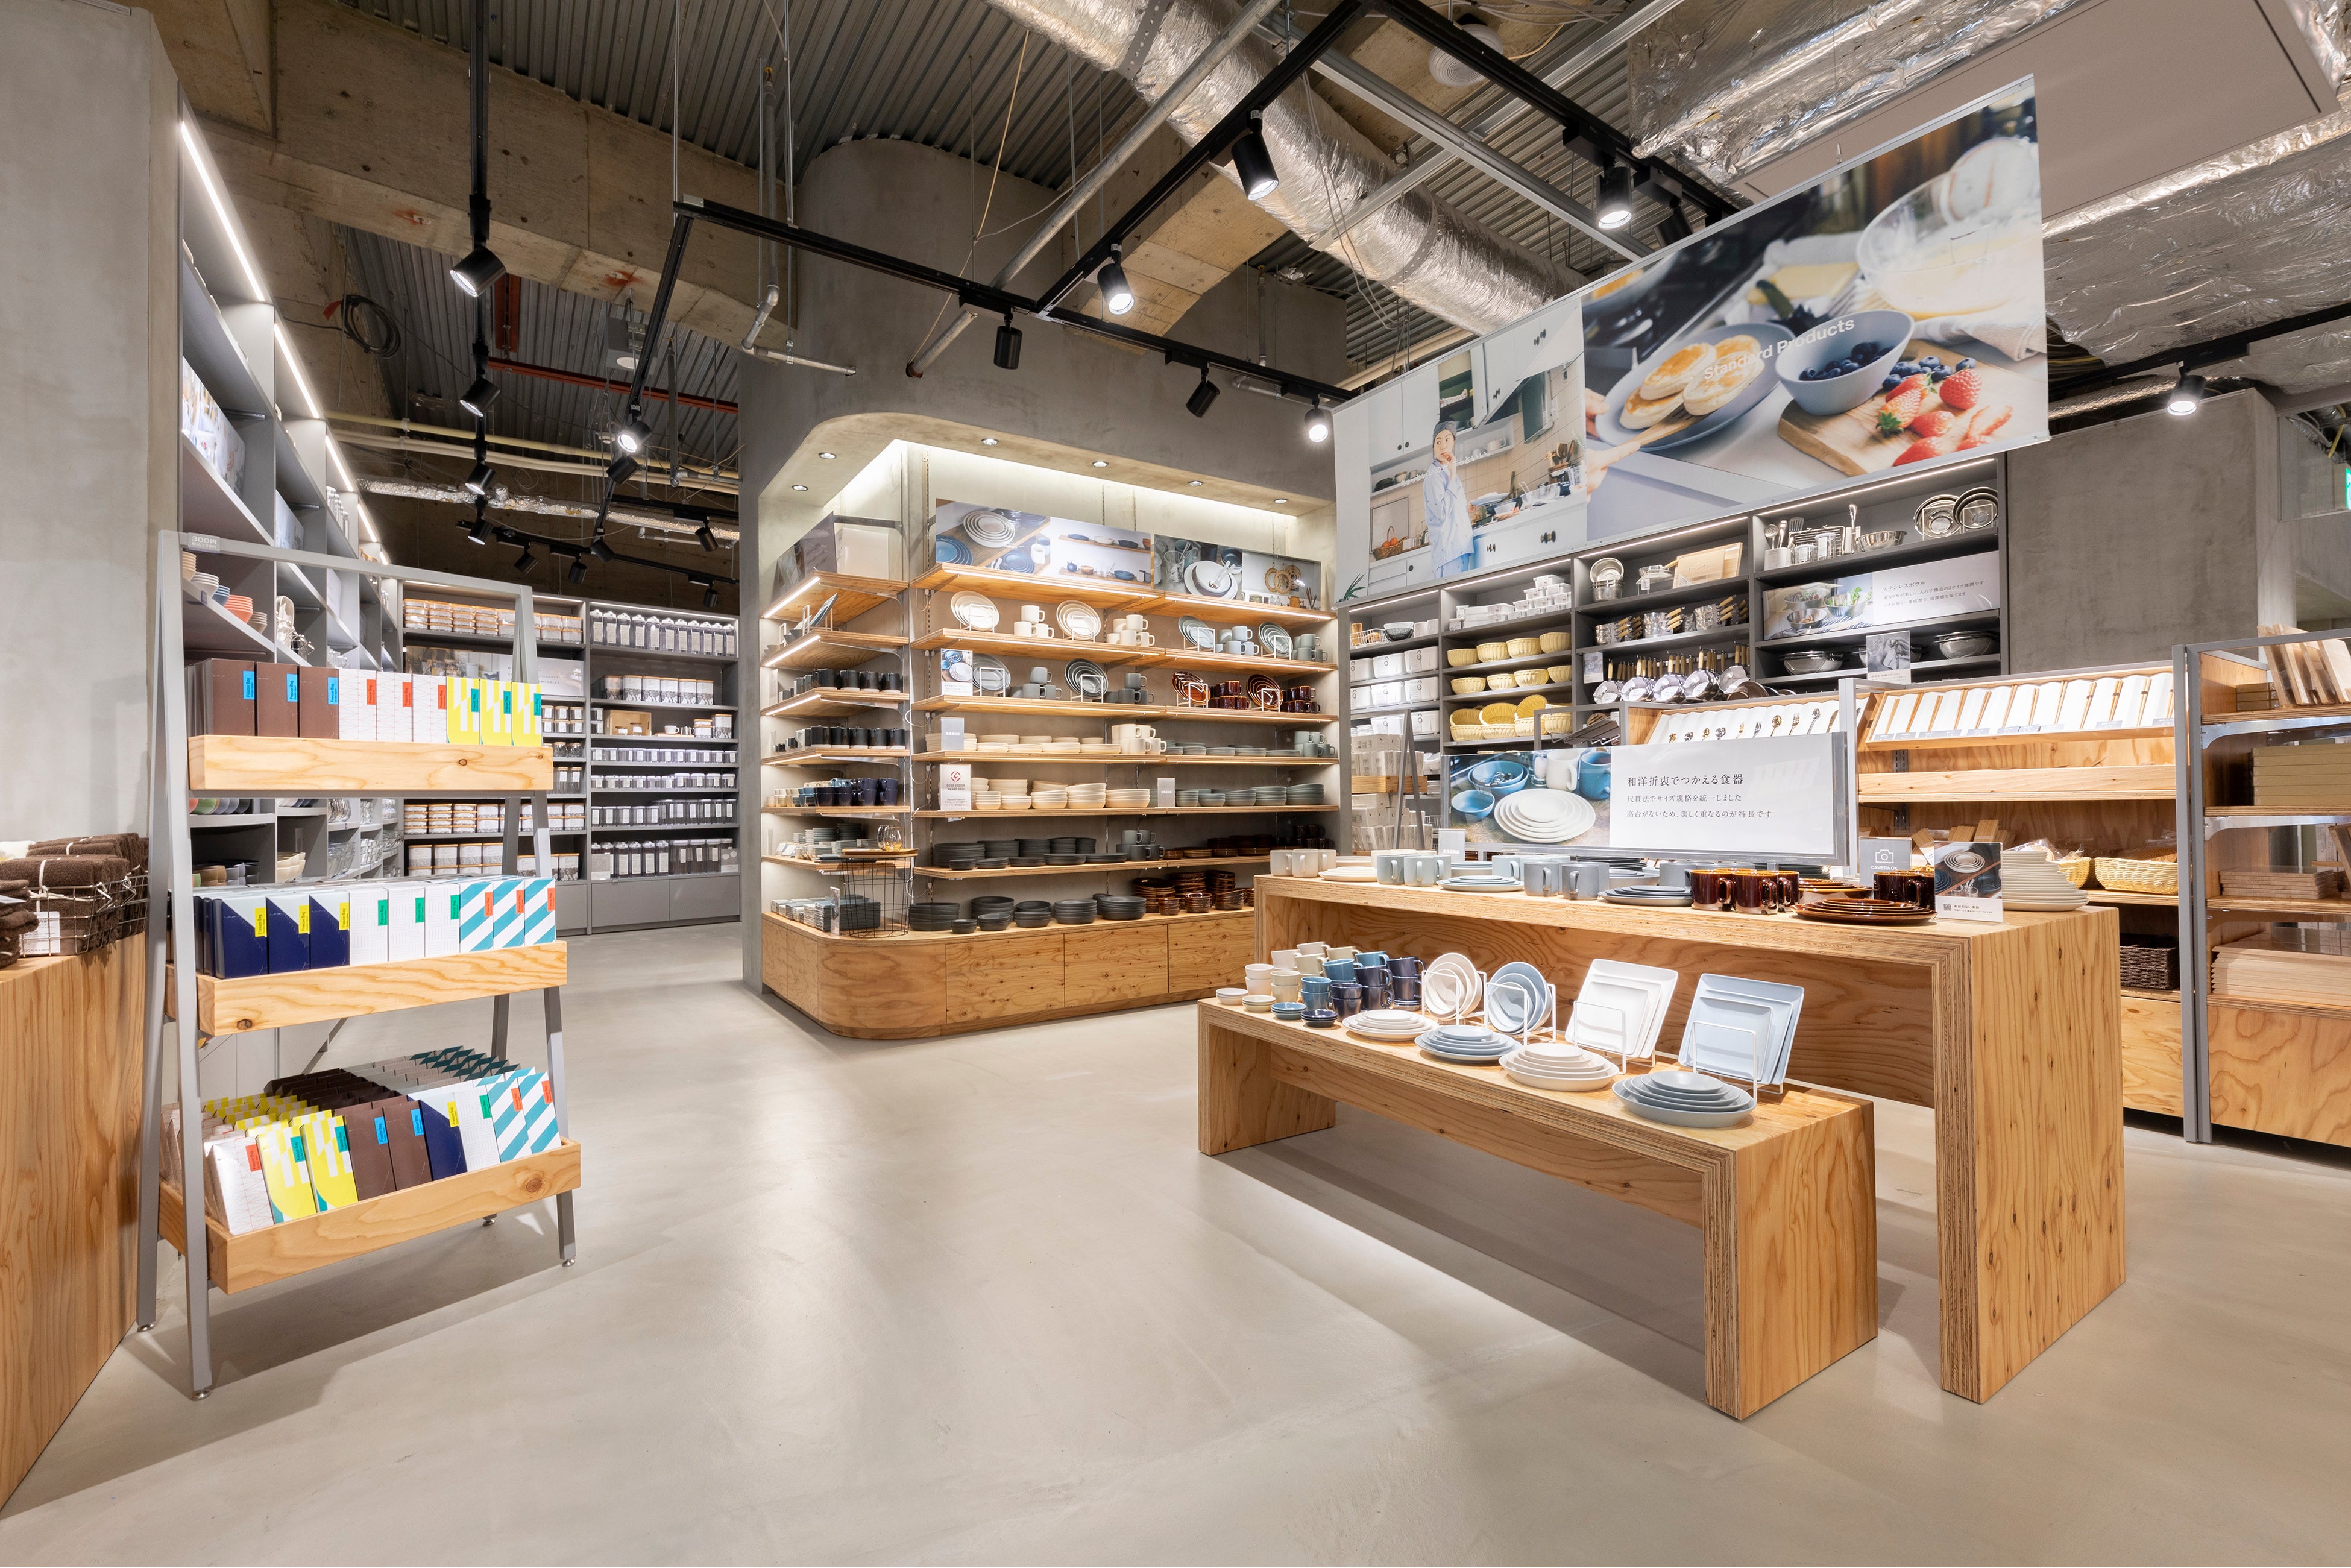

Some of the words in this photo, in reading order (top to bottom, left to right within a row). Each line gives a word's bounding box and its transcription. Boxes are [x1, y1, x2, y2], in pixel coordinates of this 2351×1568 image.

[1704, 344, 1773, 380] Standard
[1777, 318, 1855, 354] Products
[192, 536, 217, 545] 300円
[1883, 581, 1926, 591] ステンレスボウル
[1627, 773, 1743, 787] 和洋折衷でつかえる食器
[1627, 794, 1742, 802] 尺貫法でサイズ規格を統一しました
[1627, 810, 1772, 818] 高台がないため、美しく重なるのが特長です
